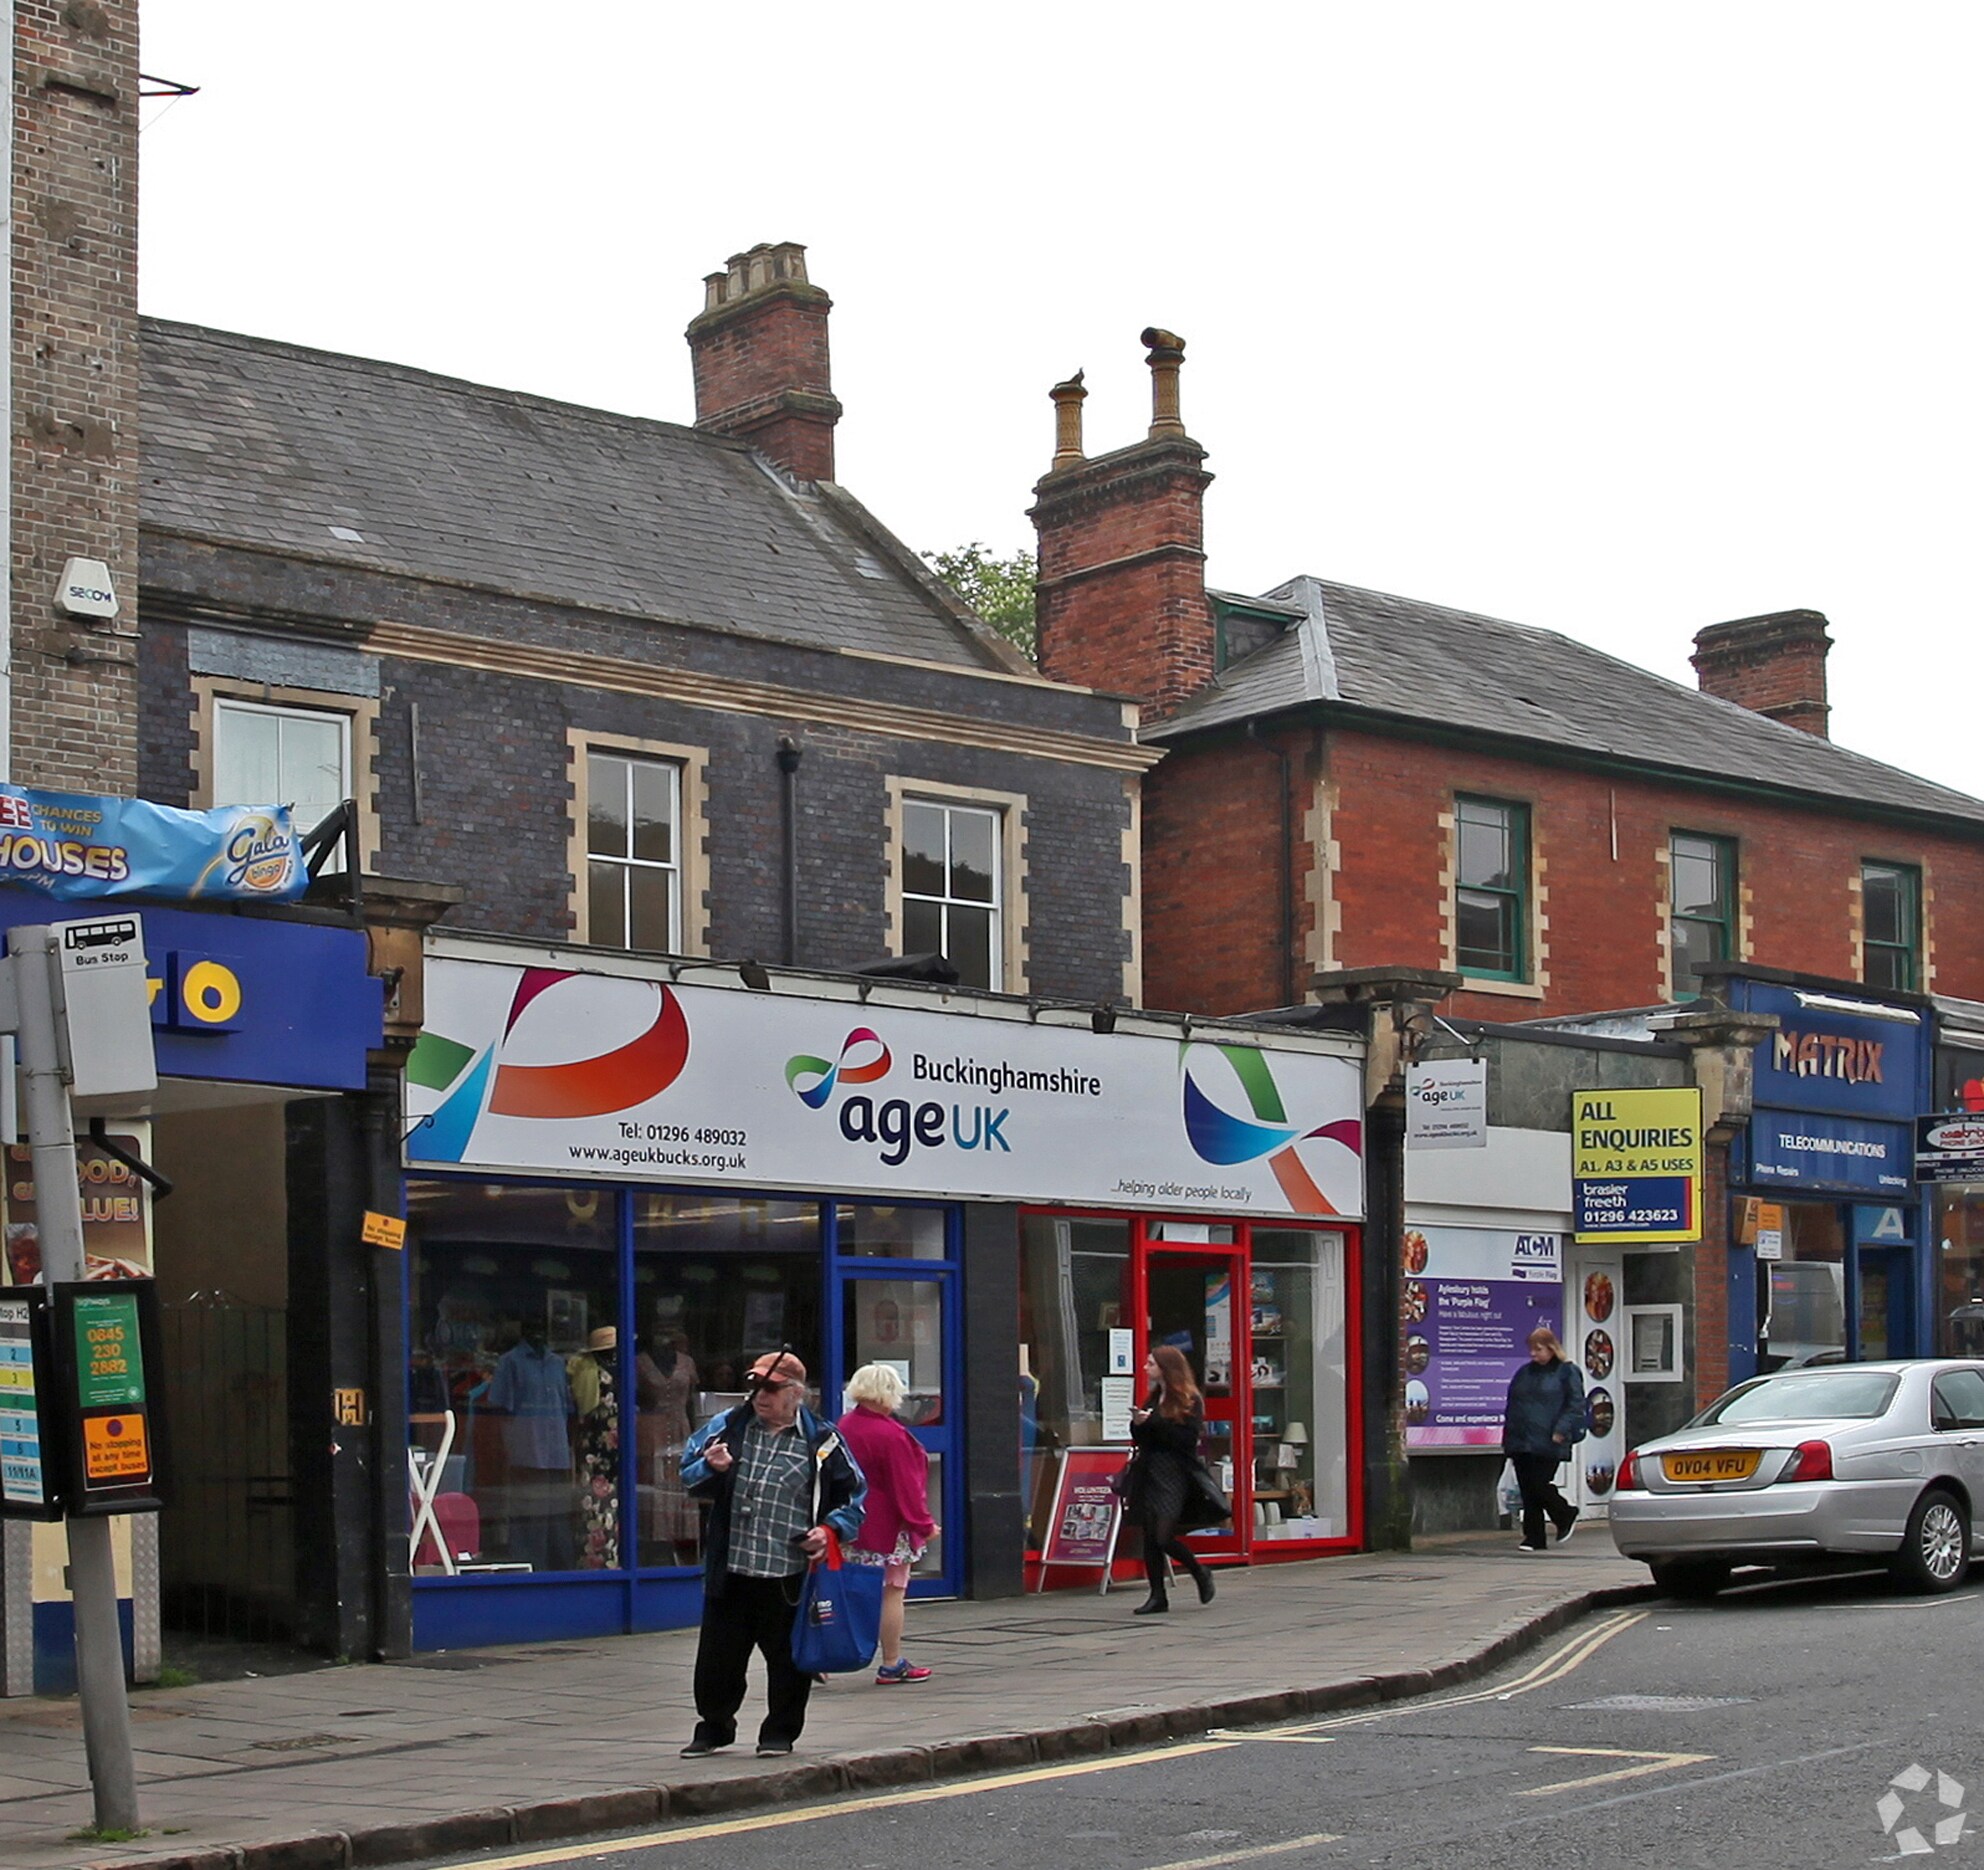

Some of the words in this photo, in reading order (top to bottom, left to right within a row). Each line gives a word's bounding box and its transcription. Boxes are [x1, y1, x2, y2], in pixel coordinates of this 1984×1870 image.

[69, 586, 112, 602] SECOM
[31, 804, 102, 823] CHANCES
[40, 820, 56, 831] TO
[60, 822, 93, 836] WIN
[225, 827, 290, 886] Gala
[251, 864, 280, 879] bingo
[76, 955, 98, 965] Bus
[102, 952, 129, 963] Stop
[1773, 1029, 1884, 1084] MATRIX
[913, 1054, 1101, 1096] Buckinghamshire
[1580, 1102, 1617, 1120] ALL
[618, 1122, 642, 1139] Tel:
[647, 1125, 689, 1142] 01296
[694, 1128, 746, 1146] 489032
[1581, 1128, 1693, 1152] ENQUIRIES
[1779, 1134, 1886, 1158] TELECOMMUNICATIONS
[569, 1146, 746, 1171] www.ageukbucks.org.uk
[1605, 1161, 1623, 1171] A3
[1627, 1160, 1637, 1171] &
[1640, 1160, 1658, 1171] A5
[1662, 1159, 1694, 1171] USES
[1756, 1163, 1775, 1174] Phone
[1777, 1164, 1799, 1176] Repairs
[1158, 1182, 1183, 1196] older
[1185, 1185, 1218, 1200] people
[1221, 1186, 1252, 1203] locally
[1583, 1183, 1628, 1196] brasier
[1584, 1196, 1627, 1208] freeth
[1584, 1211, 1625, 1222] 01296
[1628, 1209, 1678, 1221] 423623
[87, 1327, 124, 1342] 0845
[92, 1344, 121, 1358] 230
[90, 1360, 127, 1375] 2882
[12, 1372, 17, 1384] 3
[106, 1439, 142, 1448] stopping
[1674, 1461, 1710, 1475] OV04
[1716, 1459, 1745, 1473] VFU
